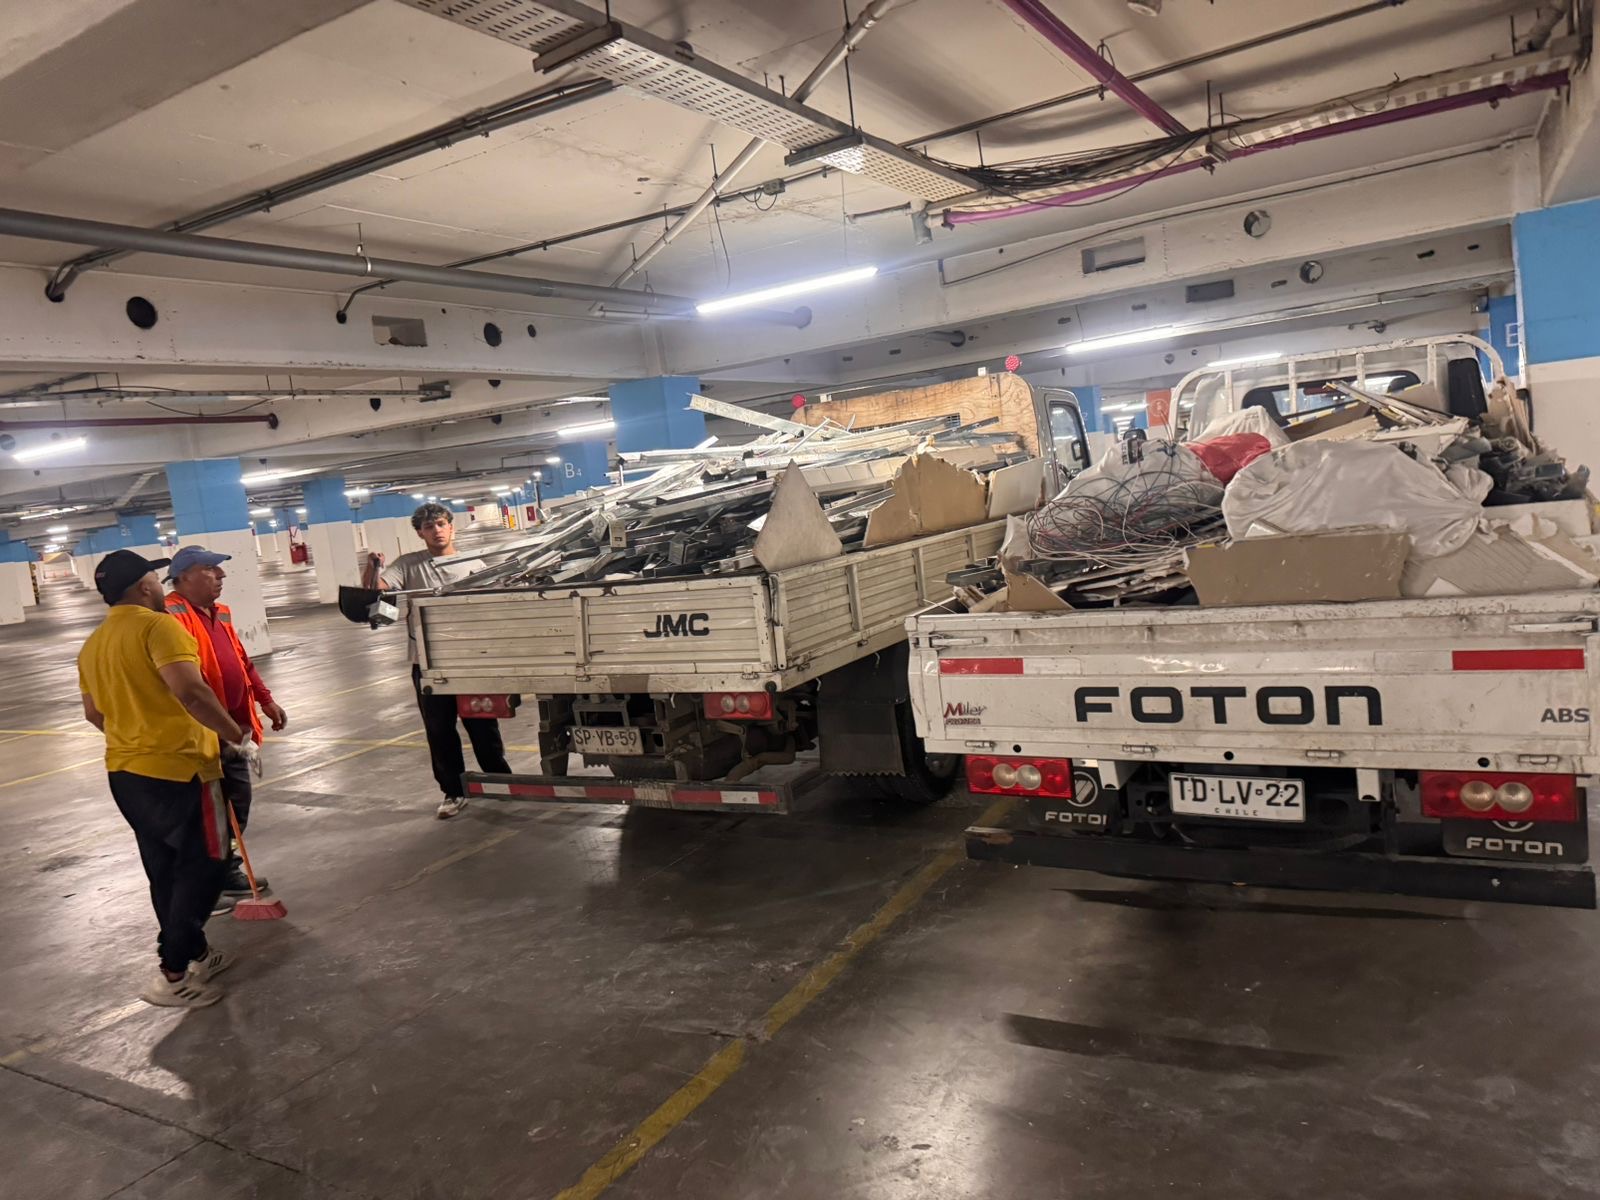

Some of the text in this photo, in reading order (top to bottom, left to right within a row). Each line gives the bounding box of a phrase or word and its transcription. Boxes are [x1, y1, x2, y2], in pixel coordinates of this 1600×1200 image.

[643, 613, 710, 638] JMC
[1074, 685, 1383, 726] FOTON
[1540, 708, 1590, 723] ABS
[1214, 807, 1259, 816] CHILE
[1466, 836, 1563, 856] FOTON
